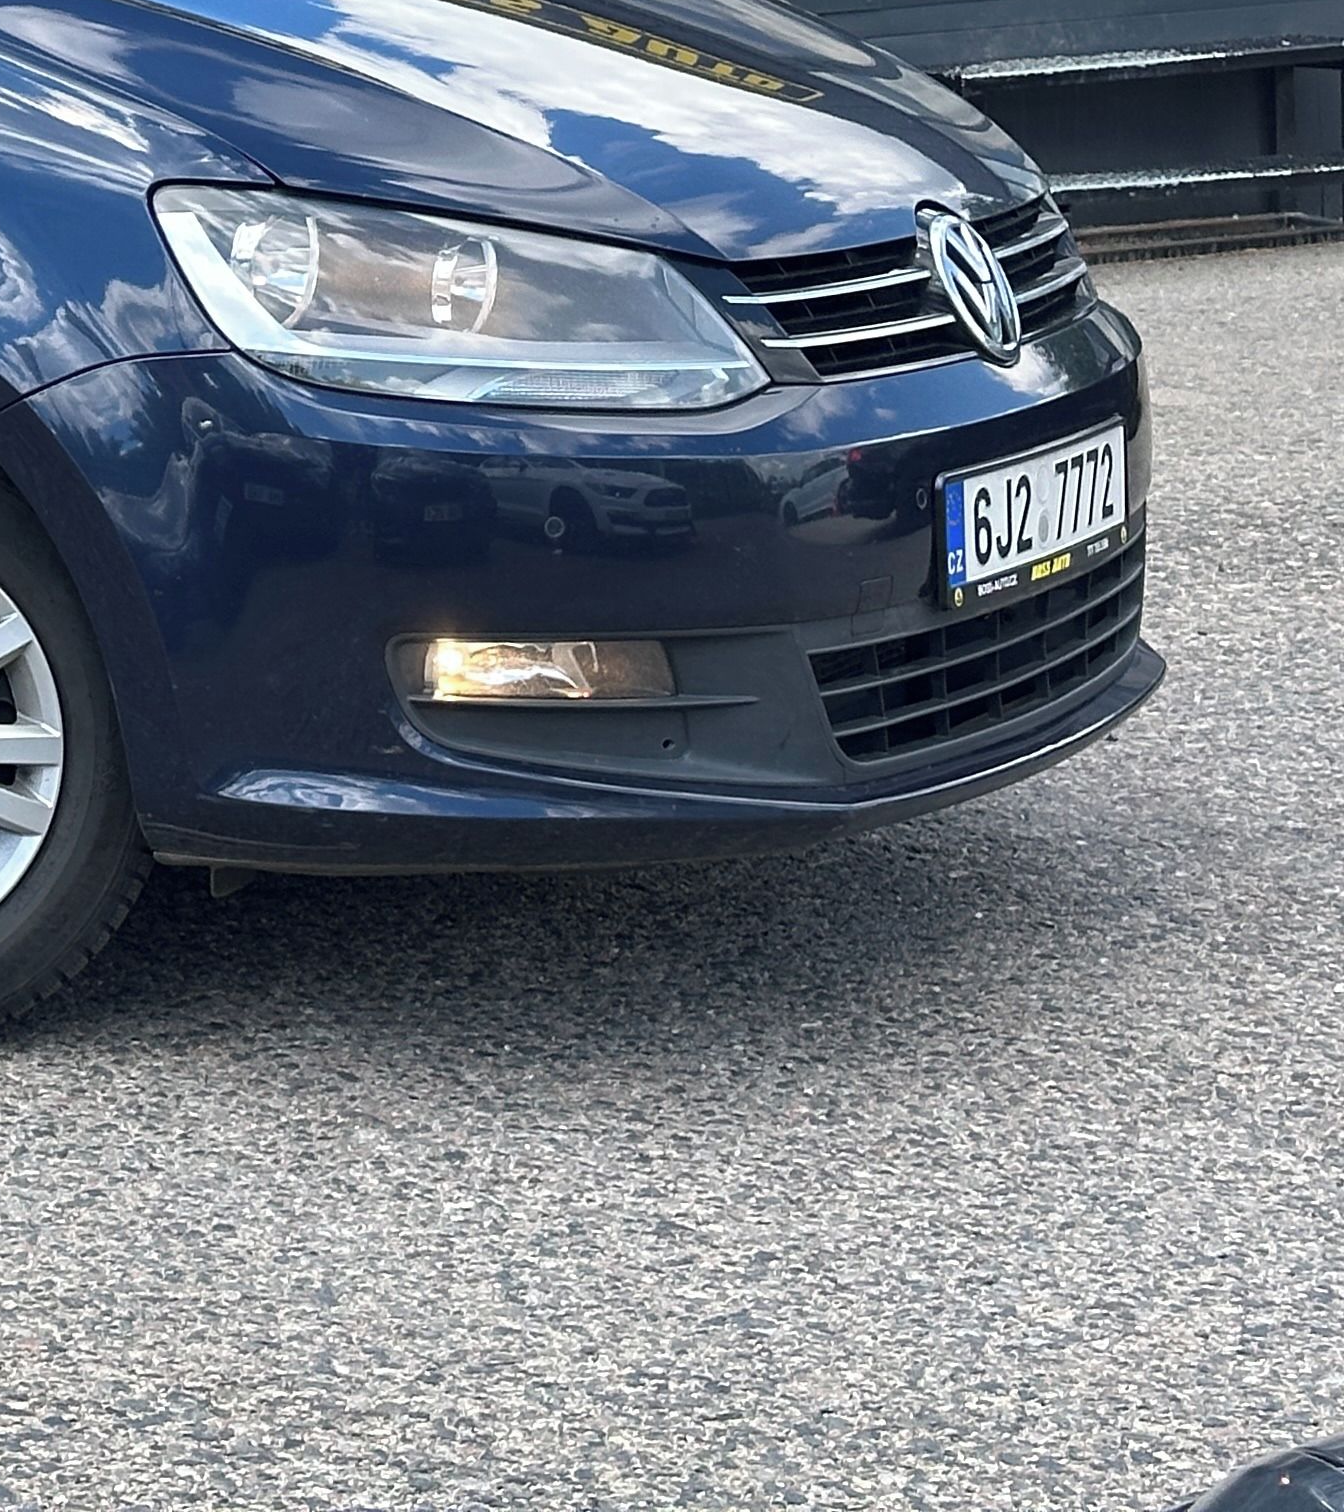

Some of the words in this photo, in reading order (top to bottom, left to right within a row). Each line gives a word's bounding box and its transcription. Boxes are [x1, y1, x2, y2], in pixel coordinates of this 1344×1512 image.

[973, 473, 1033, 566] 6J2
[1054, 442, 1114, 541] 7772
[947, 549, 965, 575] CZ
